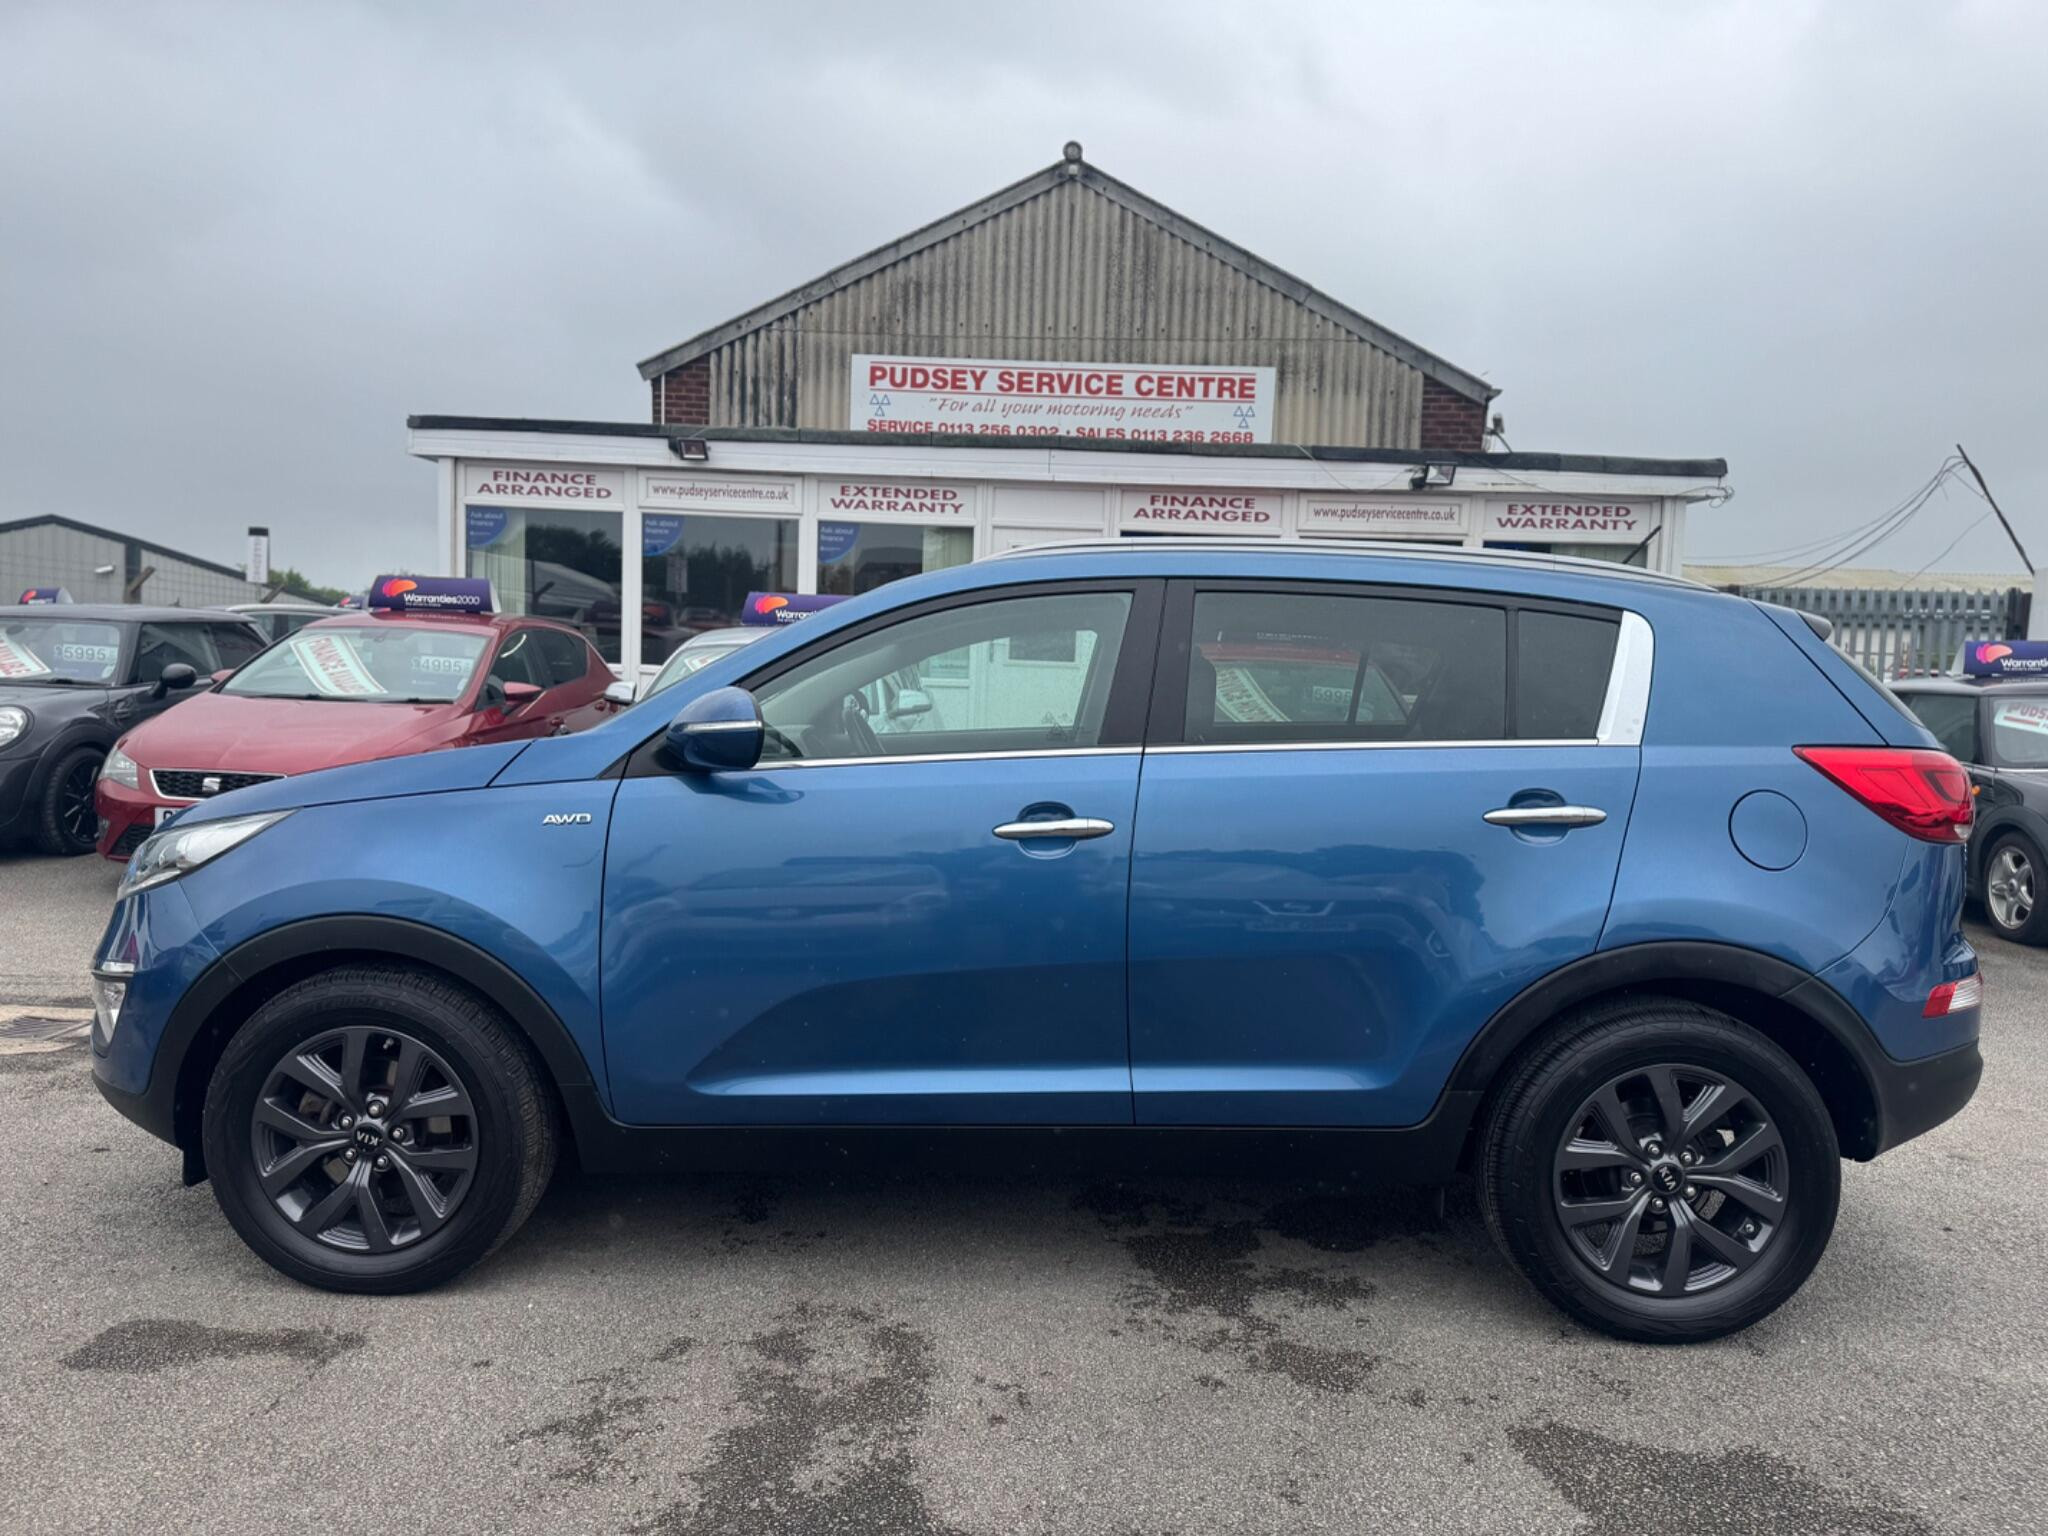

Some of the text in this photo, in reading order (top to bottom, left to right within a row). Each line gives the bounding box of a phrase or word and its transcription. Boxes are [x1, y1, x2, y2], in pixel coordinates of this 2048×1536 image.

[869, 365, 1256, 399] PUDSEY SERVICE CENTRE
[971, 399, 996, 413] all
[1001, 402, 1043, 418] your
[1046, 403, 1126, 421] motoring
[867, 418, 1254, 444] SERVICE 0113 256 0302 SALES 0113 236 2668
[492, 470, 597, 486] FINANCE
[476, 482, 612, 499] ARRANGED
[652, 482, 790, 501] www.pudseyservicecentre.co.uk
[840, 485, 957, 501] EXTENDED
[830, 498, 963, 514] WARRANTY
[1150, 494, 1256, 510] FINANCE
[1133, 507, 1270, 523] ARRANGED
[1313, 504, 1456, 523] www.pudseyservicecentre.co.uk
[1507, 503, 1631, 518] EXTENDED
[1496, 517, 1637, 531] WARRANTY
[403, 592, 480, 605] Warranties2000
[542, 812, 592, 826] AWD
